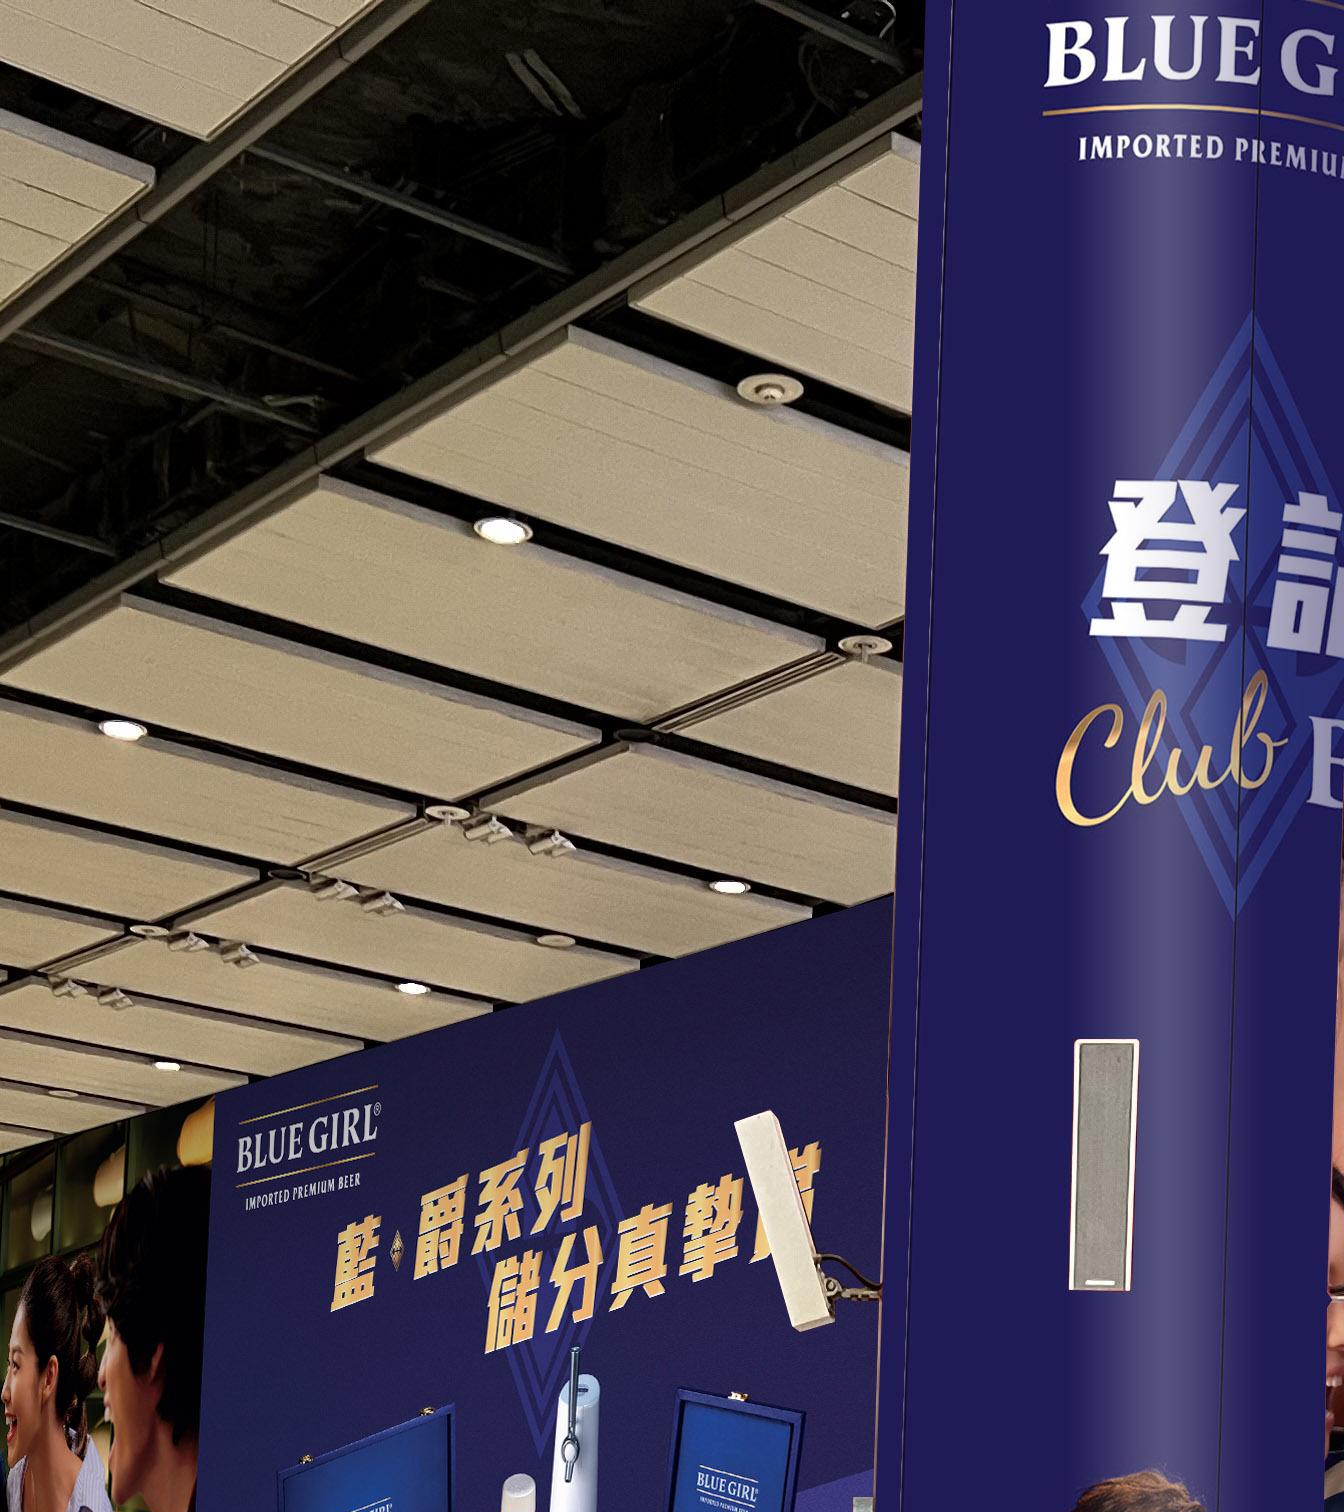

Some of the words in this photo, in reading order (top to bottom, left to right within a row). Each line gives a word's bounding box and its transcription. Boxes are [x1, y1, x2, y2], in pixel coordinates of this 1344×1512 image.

[1044, 15, 1261, 87] BLUE
[1078, 133, 1224, 161] IMPORTED
[1055, 668, 1289, 827] Club
[237, 1122, 303, 1174] BLUE
[245, 1189, 289, 1211] IMPORTED
[292, 1178, 335, 1201] PREMIUM
[338, 1172, 360, 1190] BEER
[697, 1472, 726, 1493] BLUE
